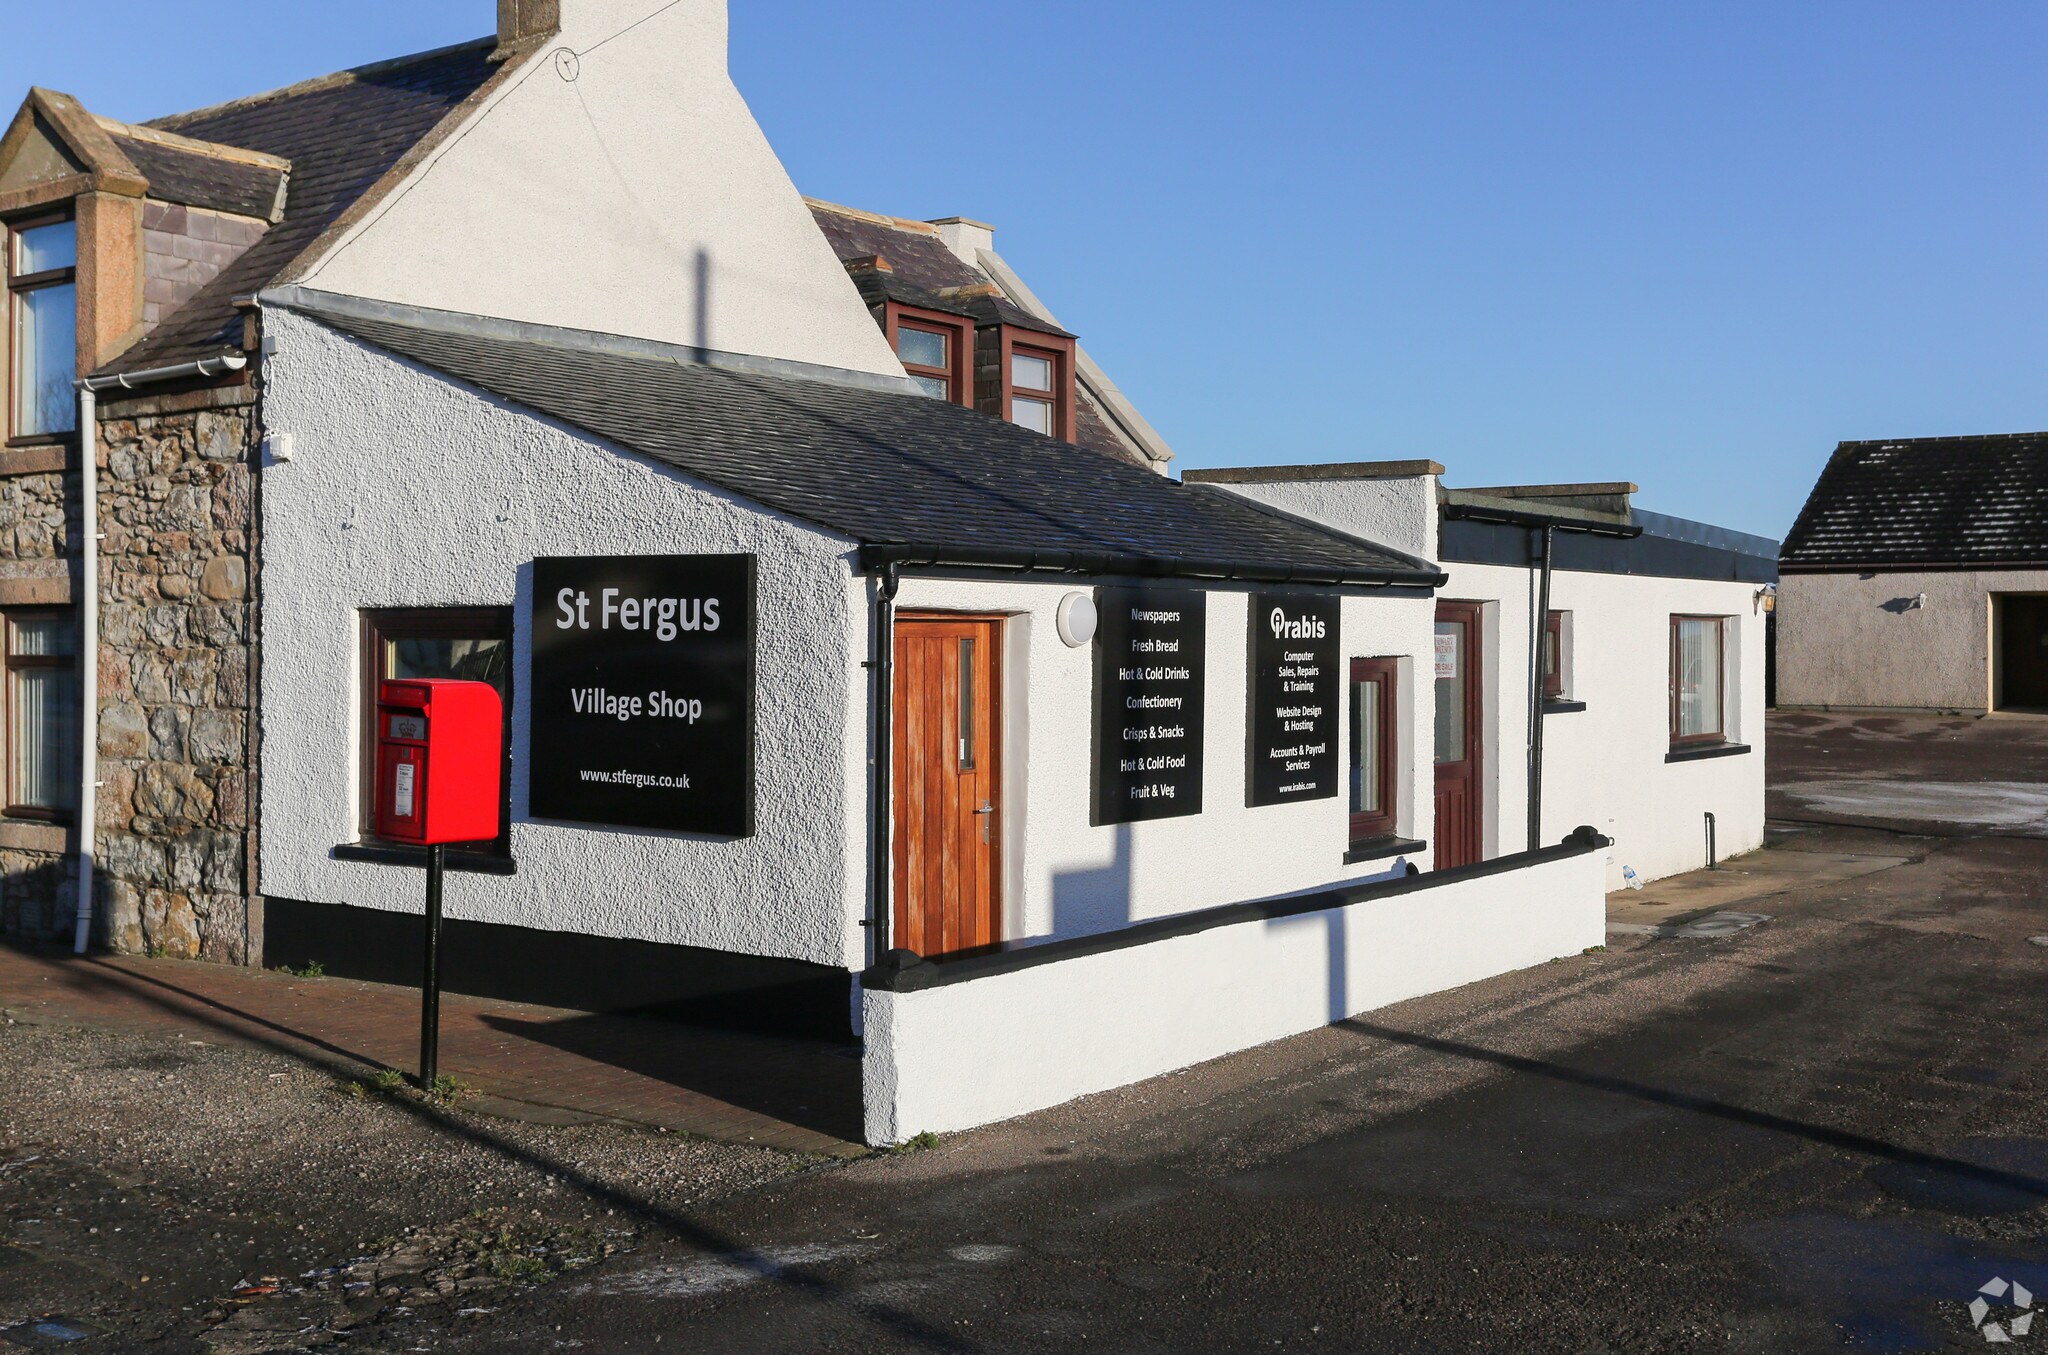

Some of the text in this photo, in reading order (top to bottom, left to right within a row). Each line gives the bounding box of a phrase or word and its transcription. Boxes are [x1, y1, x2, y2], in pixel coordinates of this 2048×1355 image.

[556, 587, 720, 642] St Fergus
[1131, 608, 1181, 624] Newspapers
[1132, 639, 1179, 652] Fresh Bread
[1284, 650, 1314, 663] Computer
[1119, 667, 1190, 681] Hot & Cold Drinks
[1278, 664, 1319, 679] Sales, Repairs
[1283, 680, 1314, 693] & Training
[571, 687, 702, 725] Village Shop
[1126, 694, 1182, 710] Confectionery
[1276, 705, 1322, 719] Website Design
[1284, 719, 1314, 732] & Hosting
[1123, 725, 1185, 742] Crisps & Snacks
[1270, 743, 1326, 759] Accounts & Payroll
[1120, 754, 1186, 772] Hot & Cold Food
[1286, 759, 1311, 771] Services
[580, 769, 690, 789] www.stfergus.co.uk
[1130, 784, 1175, 799] Fruit & Veg
[1279, 781, 1317, 793] www.irabis.com
